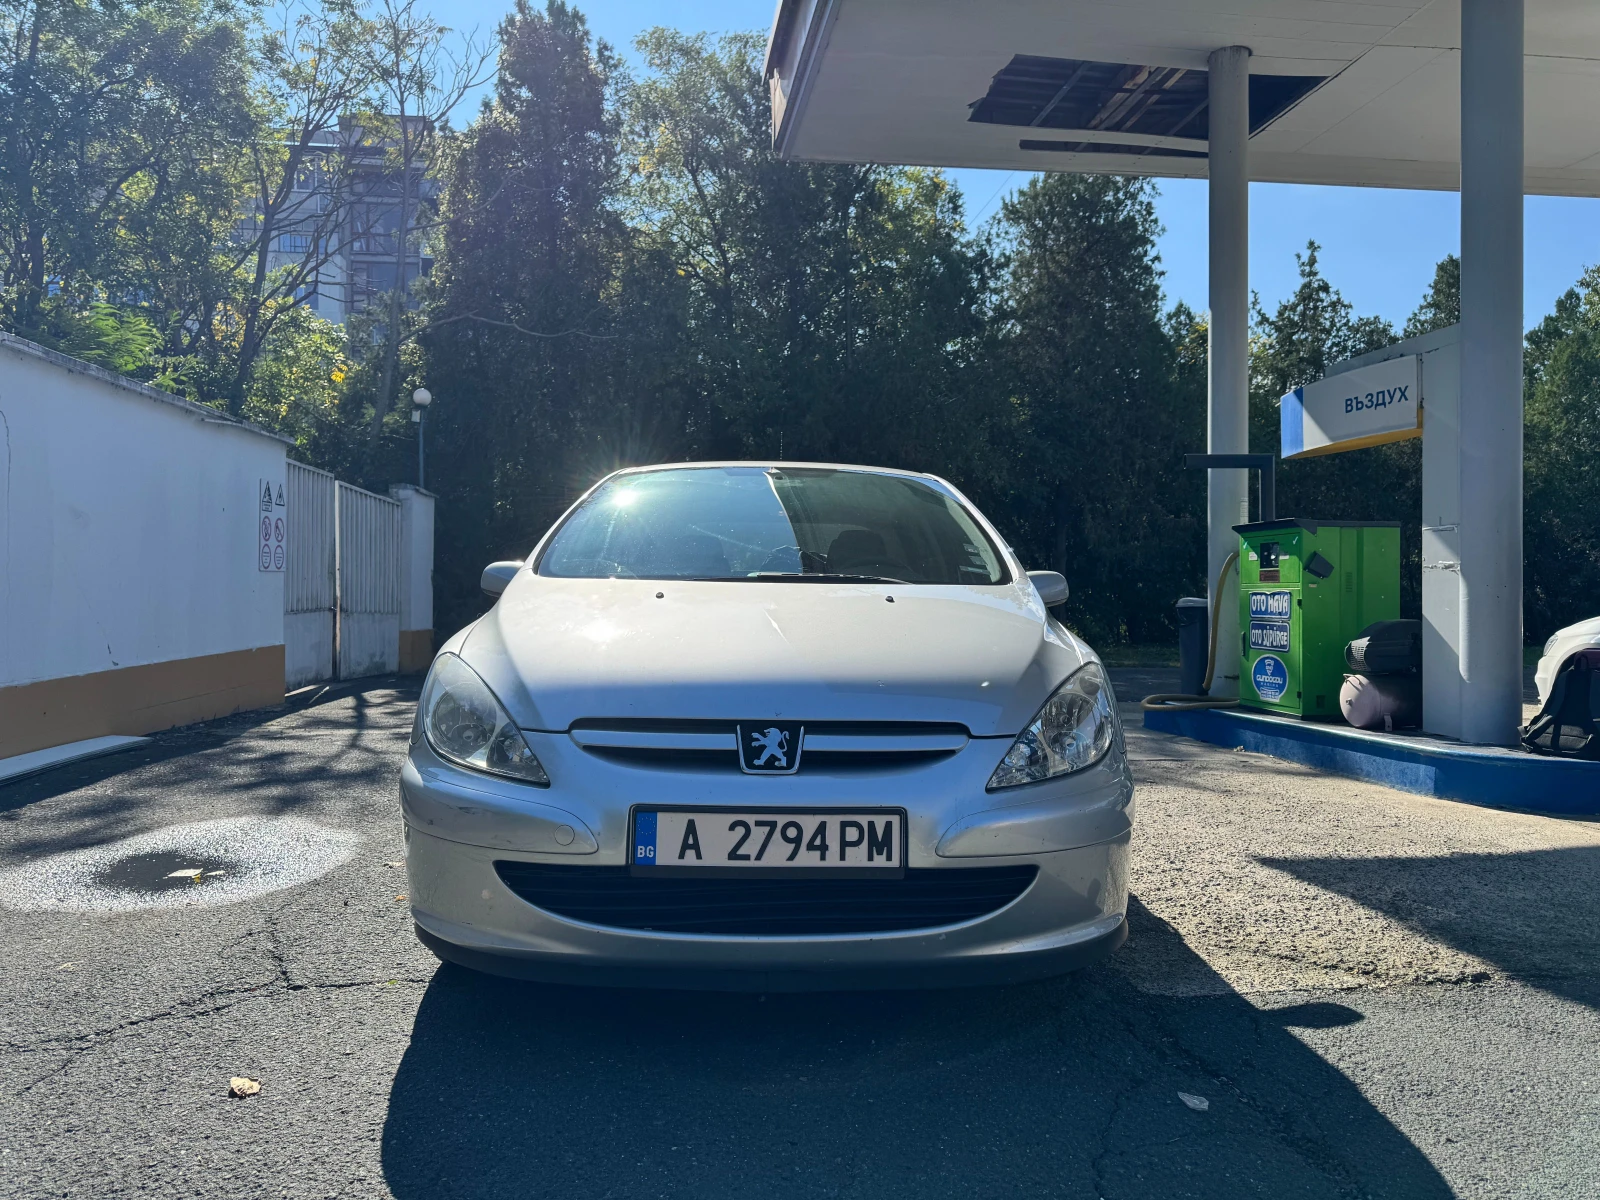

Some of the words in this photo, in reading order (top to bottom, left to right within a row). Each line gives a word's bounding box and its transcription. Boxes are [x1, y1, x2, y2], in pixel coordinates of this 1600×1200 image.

[1345, 385, 1409, 413] ВЪЗДУХ
[1251, 595, 1266, 612] OTO
[1268, 594, 1288, 613] HAVA
[1251, 629, 1262, 645] OTO
[677, 818, 703, 860] A
[727, 819, 829, 862] 2794
[839, 820, 893, 862] PM
[637, 845, 655, 858] BG
